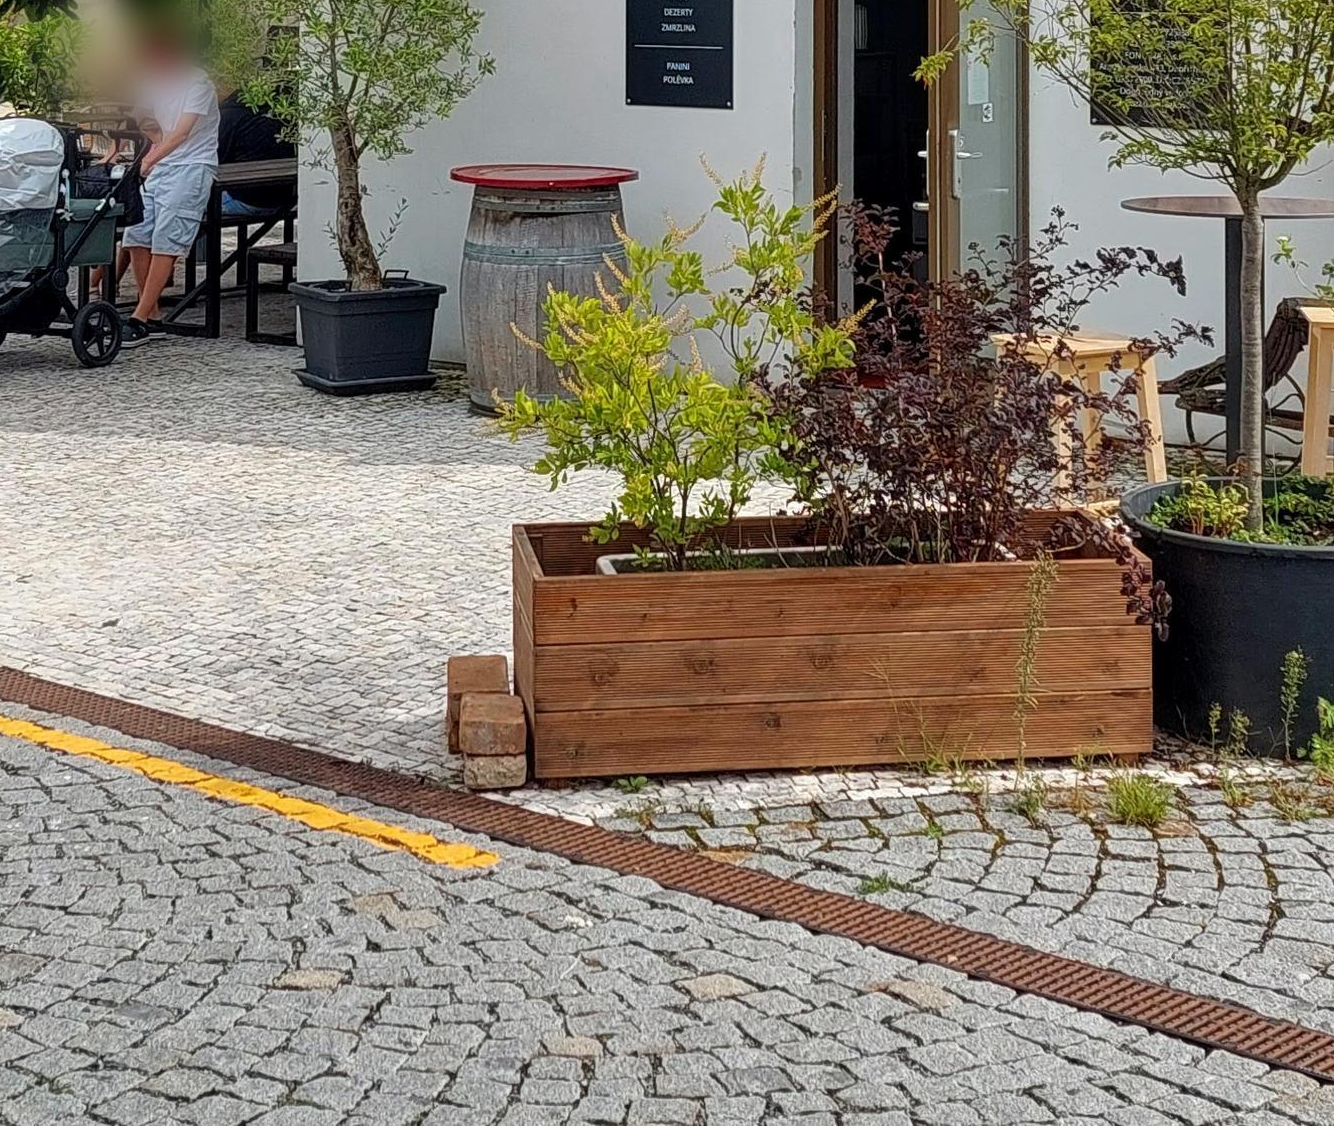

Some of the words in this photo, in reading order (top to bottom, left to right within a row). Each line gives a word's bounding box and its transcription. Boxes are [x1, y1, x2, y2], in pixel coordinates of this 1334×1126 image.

[663, 7, 694, 17] DEZERTY
[661, 23, 697, 32] ZMRZLINA
[666, 62, 690, 71] PANINI
[663, 75, 694, 84] POLÉVKA
